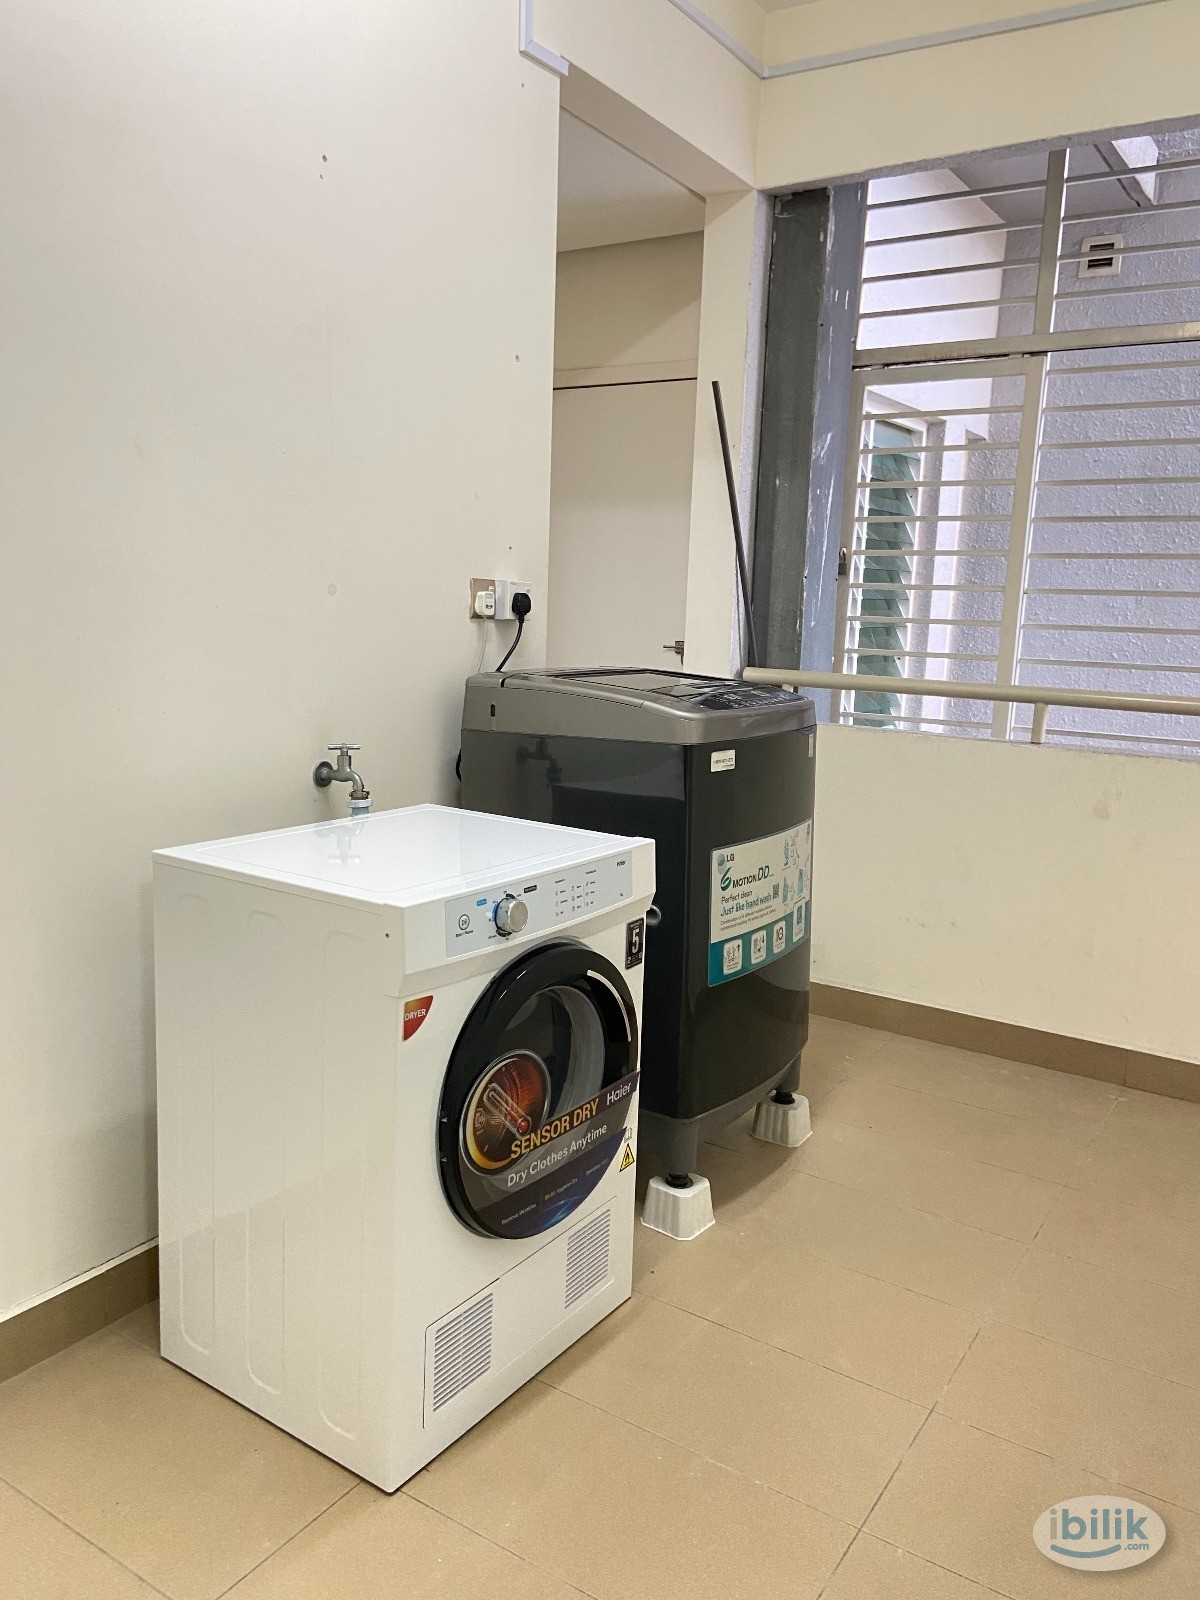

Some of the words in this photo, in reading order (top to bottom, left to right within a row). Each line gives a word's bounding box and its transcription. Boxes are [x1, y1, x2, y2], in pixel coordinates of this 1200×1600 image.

[726, 853, 735, 862] LG
[732, 875, 757, 889] MOTION
[757, 865, 770, 881] DD
[720, 905, 735, 917] Just
[735, 902, 746, 912] like
[745, 895, 760, 909] hand
[759, 892, 772, 904] wash
[721, 893, 740, 904] Perfect
[740, 890, 753, 899] clean
[632, 928, 640, 954] 5
[404, 1008, 427, 1022] DRYER
[606, 1081, 632, 1106] Haier
[510, 1118, 571, 1160] SENSOR
[573, 1098, 599, 1128] DRY
[507, 1169, 528, 1188] Dry
[529, 1145, 568, 1176] Clothes
[569, 1124, 608, 1153] Anytime
